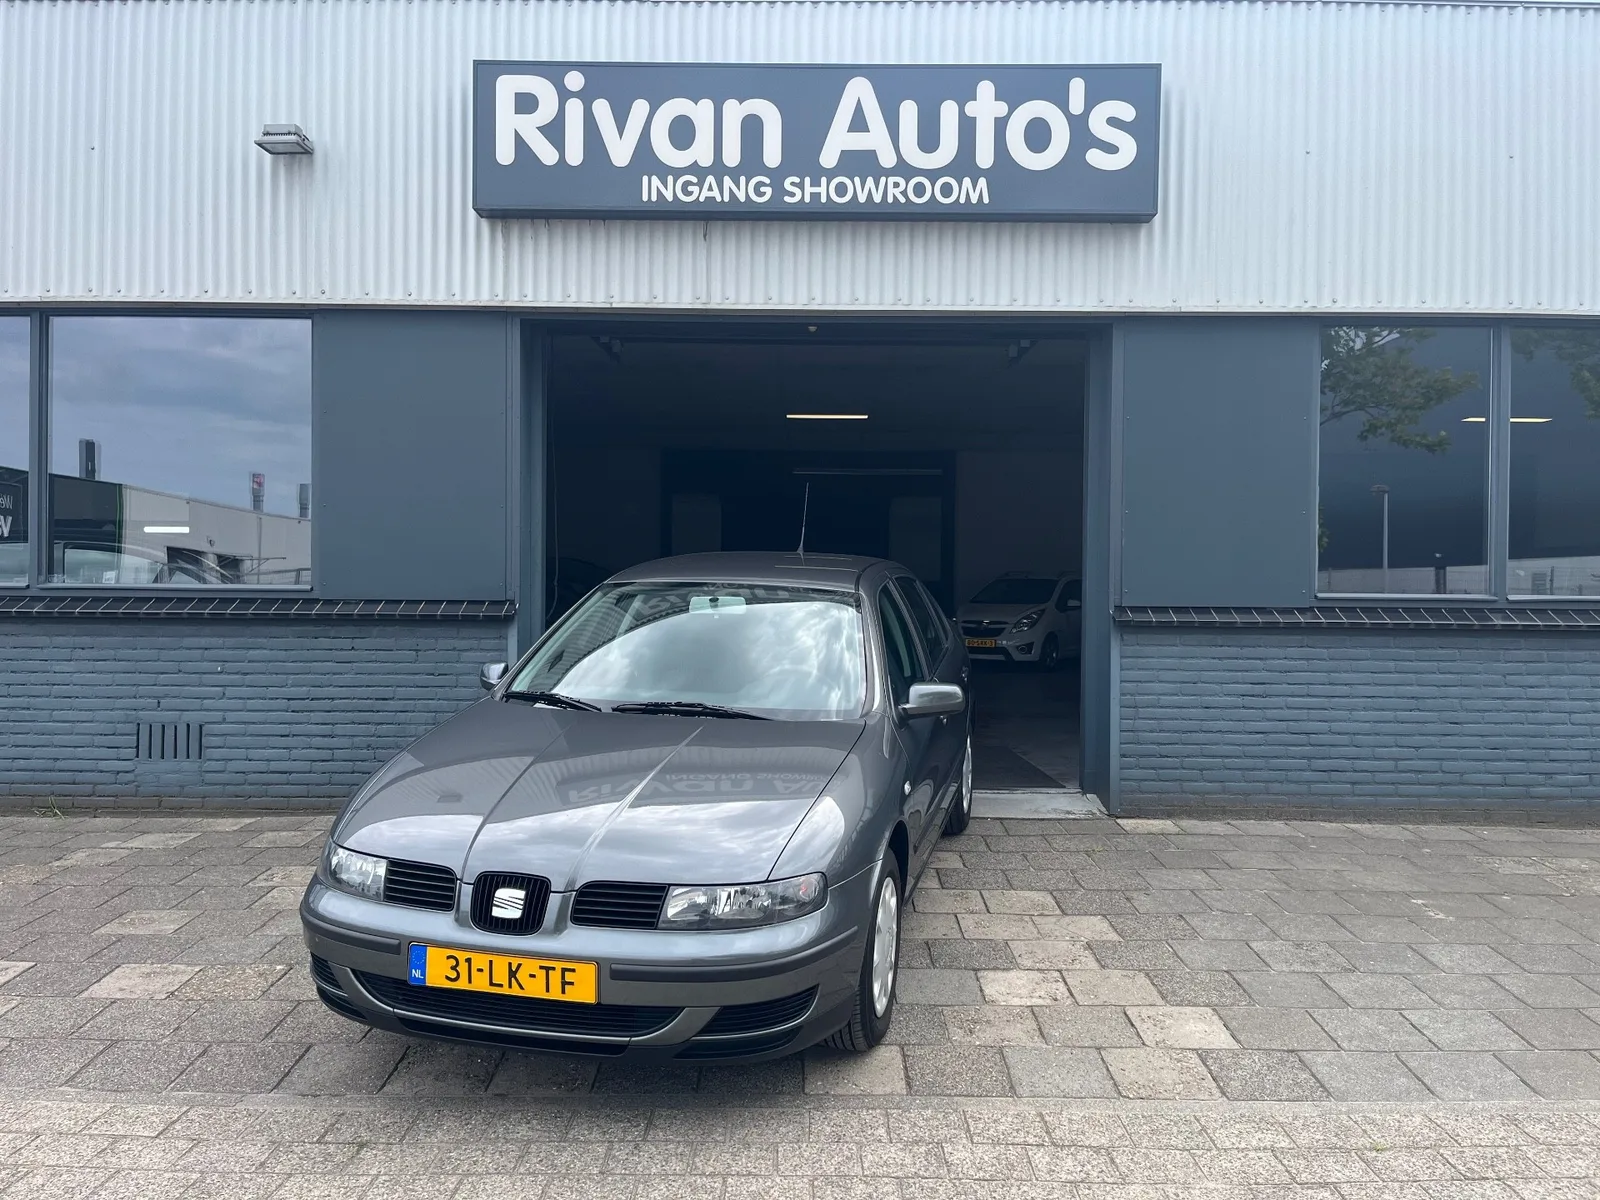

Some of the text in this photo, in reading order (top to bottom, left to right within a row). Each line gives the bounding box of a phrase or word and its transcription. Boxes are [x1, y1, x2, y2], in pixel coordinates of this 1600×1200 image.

[495, 70, 1138, 171] Rivan Auto's
[641, 174, 991, 206] INGANG SHOWROOM
[411, 968, 424, 979] NL
[444, 954, 577, 995] 31-LK-TF
